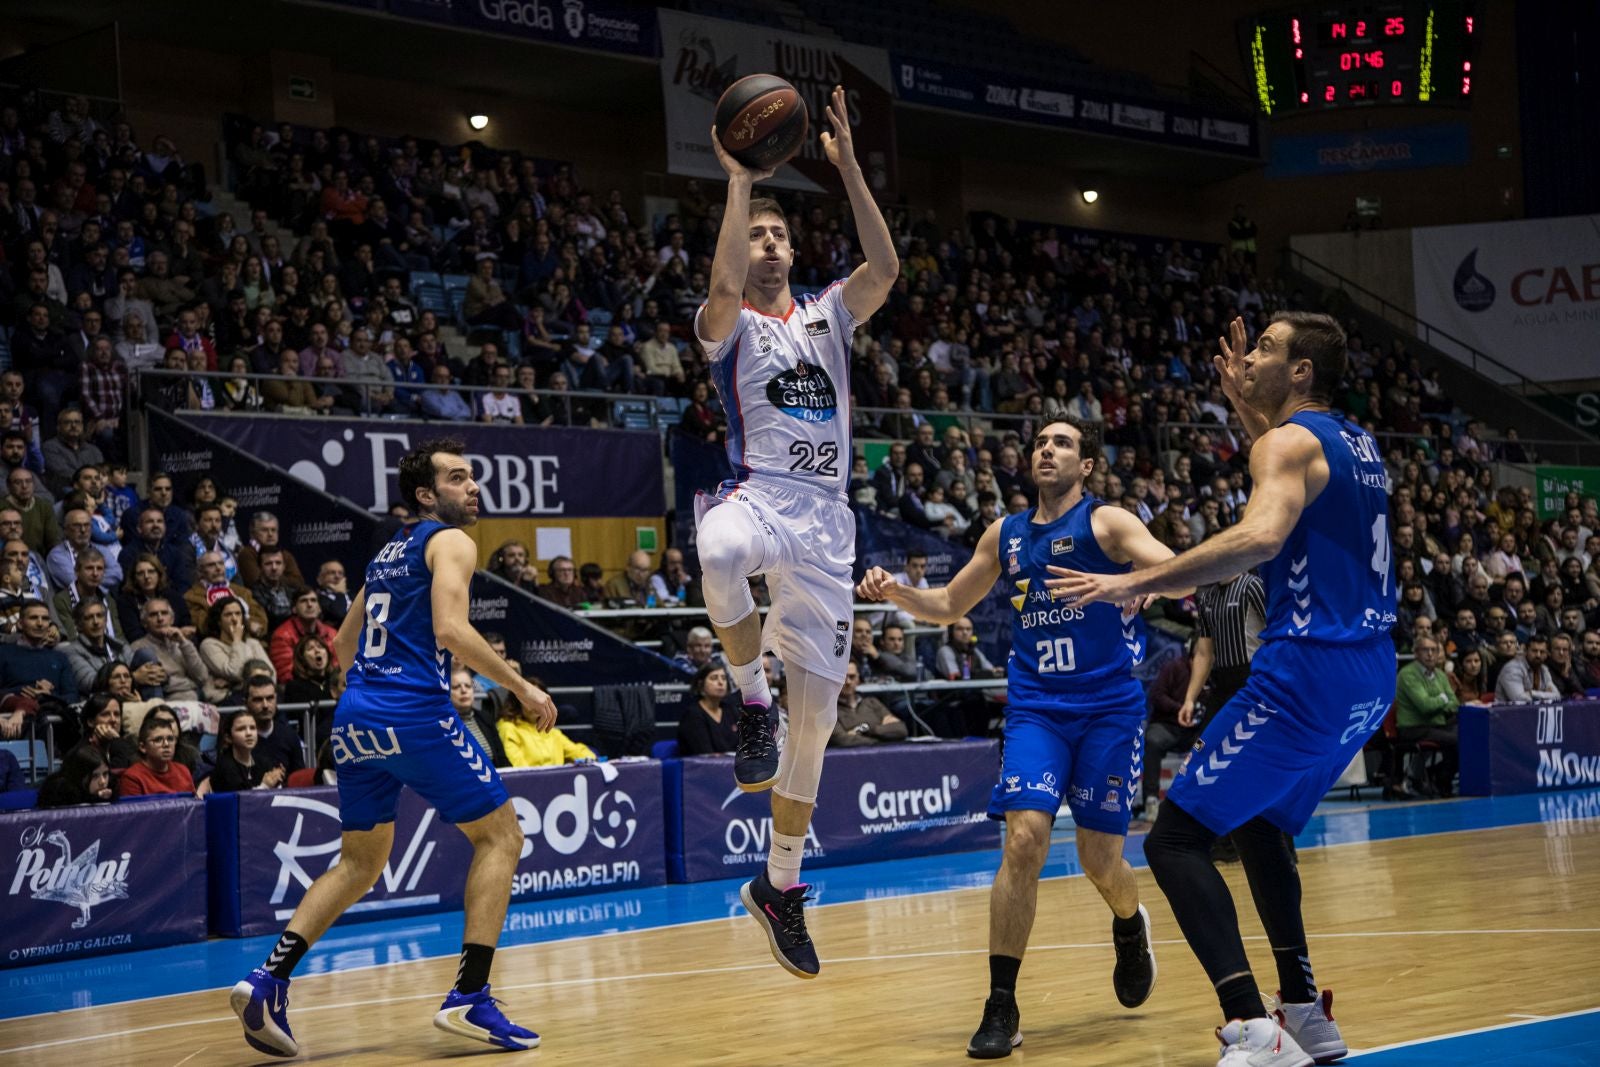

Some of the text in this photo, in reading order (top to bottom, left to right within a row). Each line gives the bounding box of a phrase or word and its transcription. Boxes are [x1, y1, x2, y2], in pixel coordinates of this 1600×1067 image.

[479, 0, 554, 31] Grada
[1332, 17, 1405, 38] 14 2 25
[985, 83, 1017, 107] ZONA
[1325, 85, 1335, 101] 2
[1391, 80, 1402, 96] 0
[1080, 99, 1109, 121] ZONA
[1318, 143, 1412, 166] PESCAMAR
[364, 432, 564, 513] FRBE
[789, 440, 838, 476] 22
[1371, 513, 1390, 597] 4
[364, 593, 391, 658] 8
[1021, 607, 1085, 630] BURGOS
[1036, 637, 1076, 674] 20
[330, 723, 401, 764] atu
[1537, 748, 1600, 787] MON
[8, 847, 132, 896] Petroni
[723, 853, 747, 865] OBRAS
[748, 853, 755, 863] Y
[510, 861, 641, 897] SPINA&DELFIN
[9, 933, 133, 961] O VERMÚ DE GALICIA
